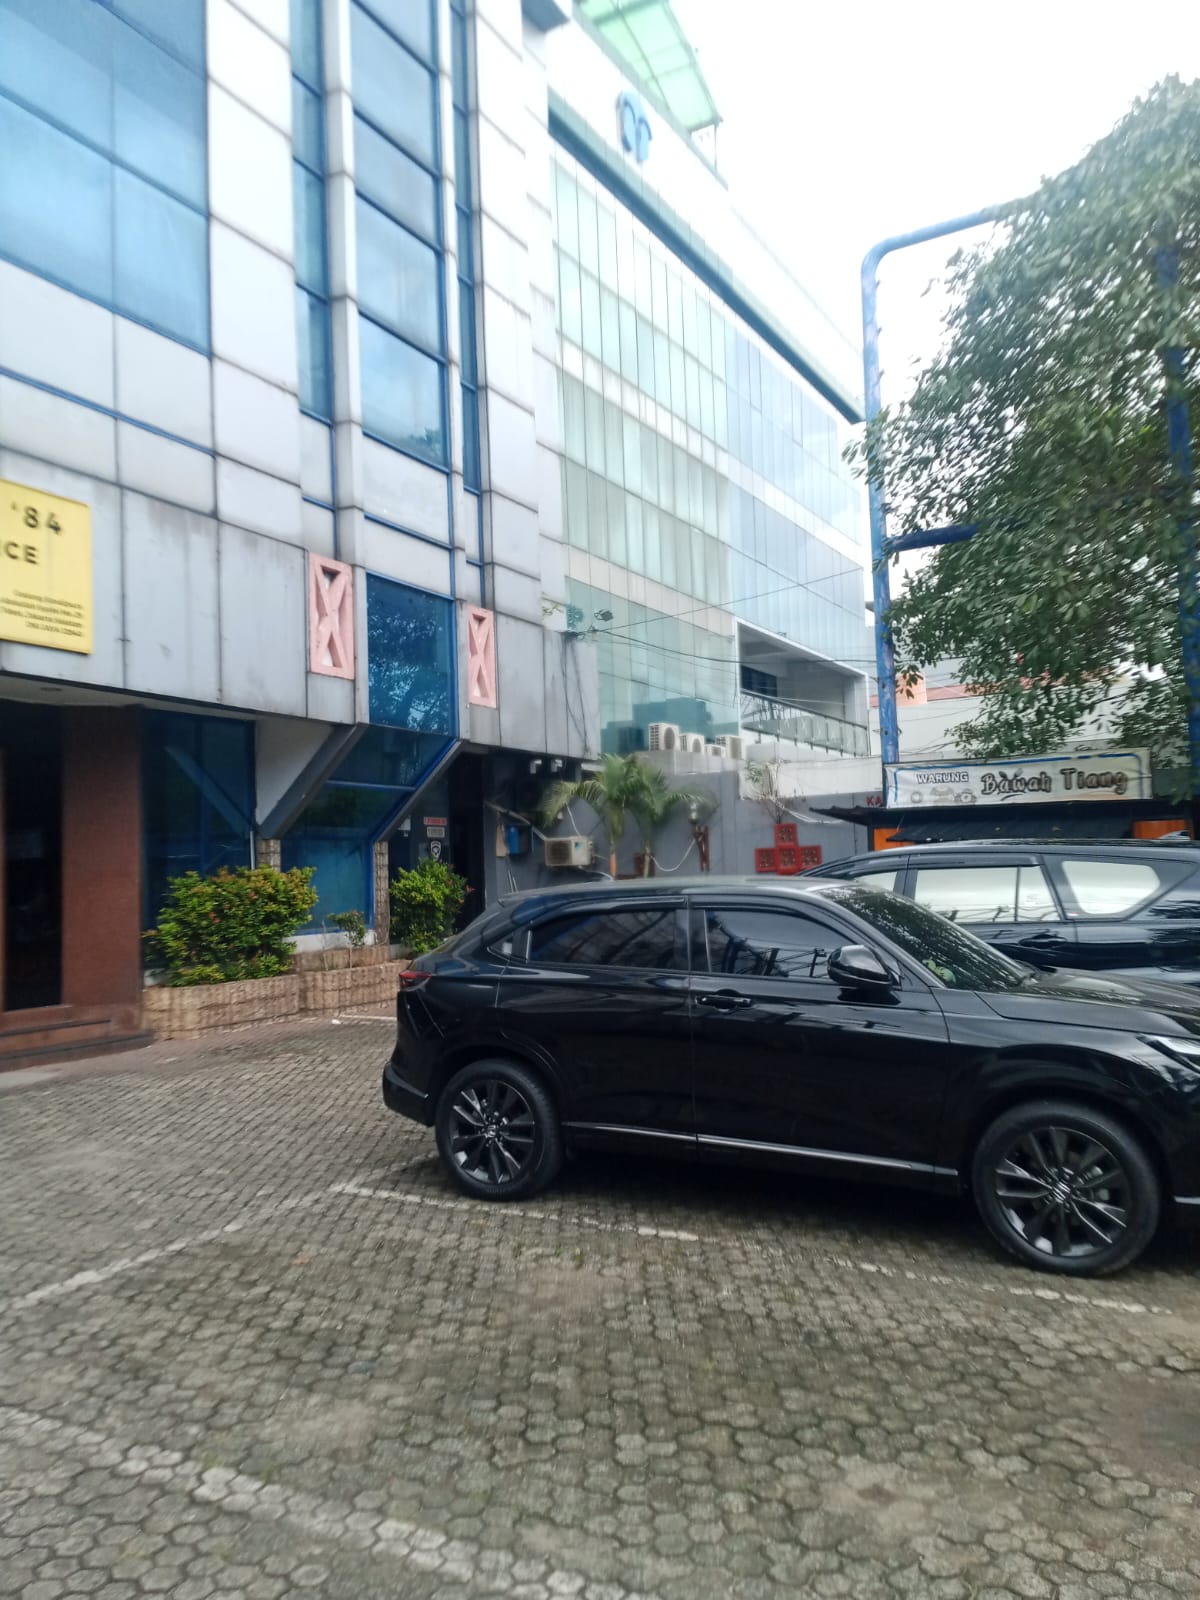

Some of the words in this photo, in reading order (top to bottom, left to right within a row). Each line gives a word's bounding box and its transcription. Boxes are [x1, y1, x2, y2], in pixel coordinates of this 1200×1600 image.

[0, 541, 38, 565] CE
[916, 771, 970, 784] WARUNG
[981, 770, 1052, 795] Bawah
[1060, 767, 1128, 795] Tiang
